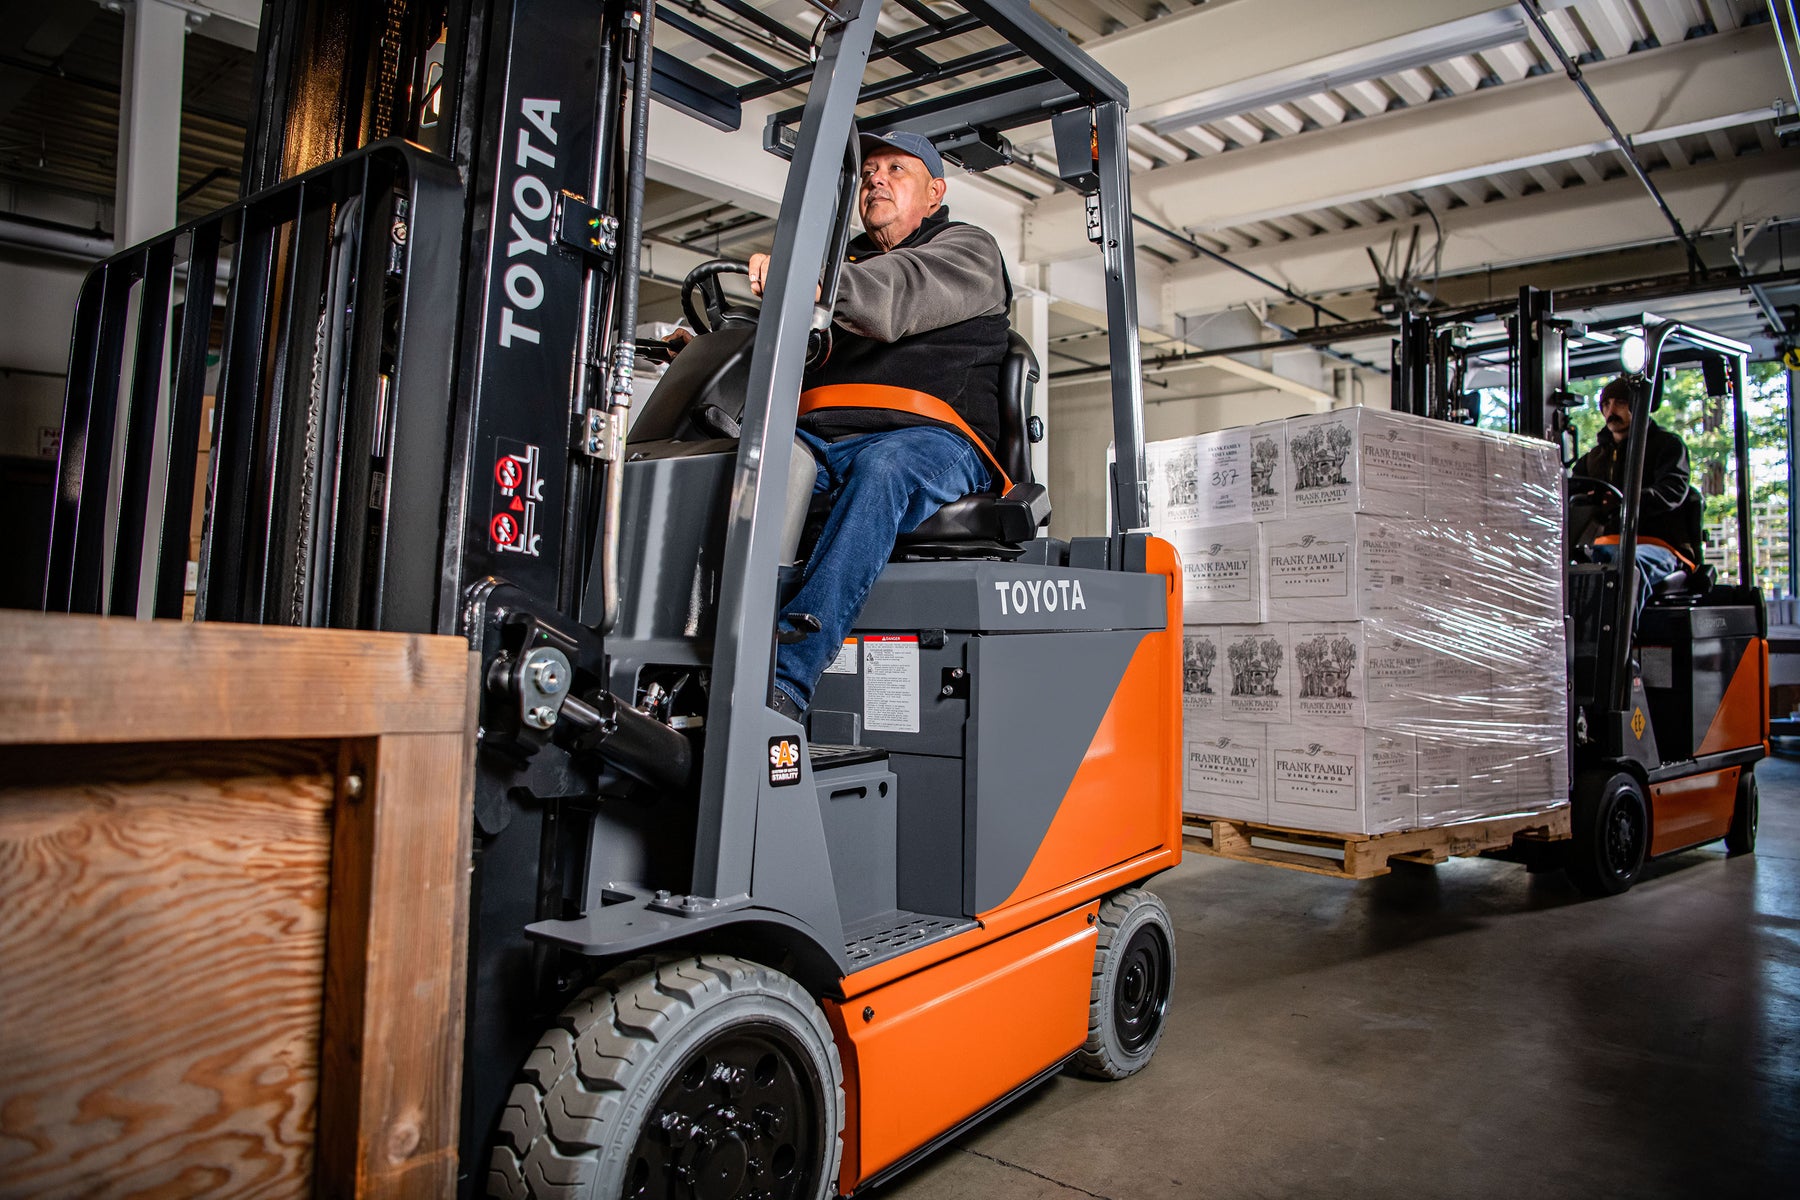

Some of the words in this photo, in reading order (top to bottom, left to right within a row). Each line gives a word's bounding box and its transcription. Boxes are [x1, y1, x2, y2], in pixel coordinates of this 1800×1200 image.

[499, 98, 560, 348] TOYOTA
[1365, 445, 1390, 458] FRANK
[1212, 468, 1240, 487] 387
[1296, 493, 1320, 502] FRANK
[1320, 488, 1348, 498] FAMILY
[1251, 500, 1274, 508] FAMILY
[1271, 555, 1304, 566] FRANK
[1306, 552, 1344, 564] FAMILY
[1184, 561, 1212, 572] FRANK
[1215, 560, 1248, 571] FAMILY
[995, 580, 1086, 615] TOYOTA
[1370, 659, 1394, 668] FRANK
[1255, 700, 1279, 708] FAMILY
[1300, 702, 1325, 710] FRANK
[1326, 702, 1353, 710] FAMILY
[770, 741, 799, 768] SAS
[1190, 752, 1221, 764] FRANK
[1222, 756, 1257, 768] FAMILY
[1200, 764, 1248, 773] VINEYARDS
[1276, 760, 1311, 772] FRANK
[1314, 763, 1353, 776] FAMILY
[772, 772, 798, 781] STABILITY
[1287, 773, 1343, 782] VINEYARDS
[608, 1060, 663, 1163] MAGNUM
